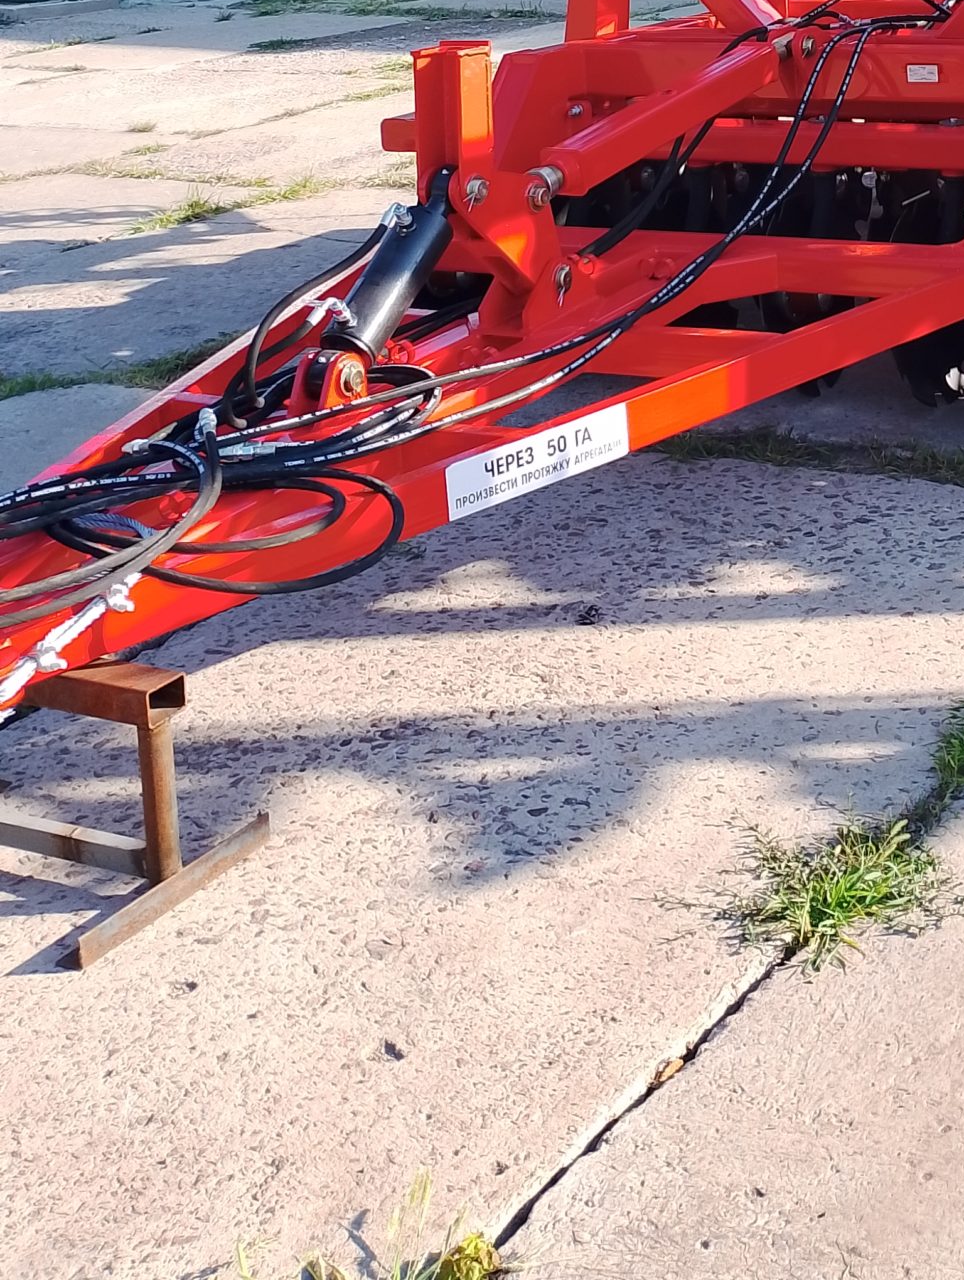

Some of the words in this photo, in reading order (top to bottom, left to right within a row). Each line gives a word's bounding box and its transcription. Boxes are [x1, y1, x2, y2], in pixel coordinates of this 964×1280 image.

[484, 447, 535, 477] ЧЕРЕЗ
[547, 435, 567, 457] 50
[574, 427, 593, 447] ГА
[455, 478, 518, 510] ПРОИЗВЕСТИ
[521, 458, 571, 486] ПРОТЯЖКУ
